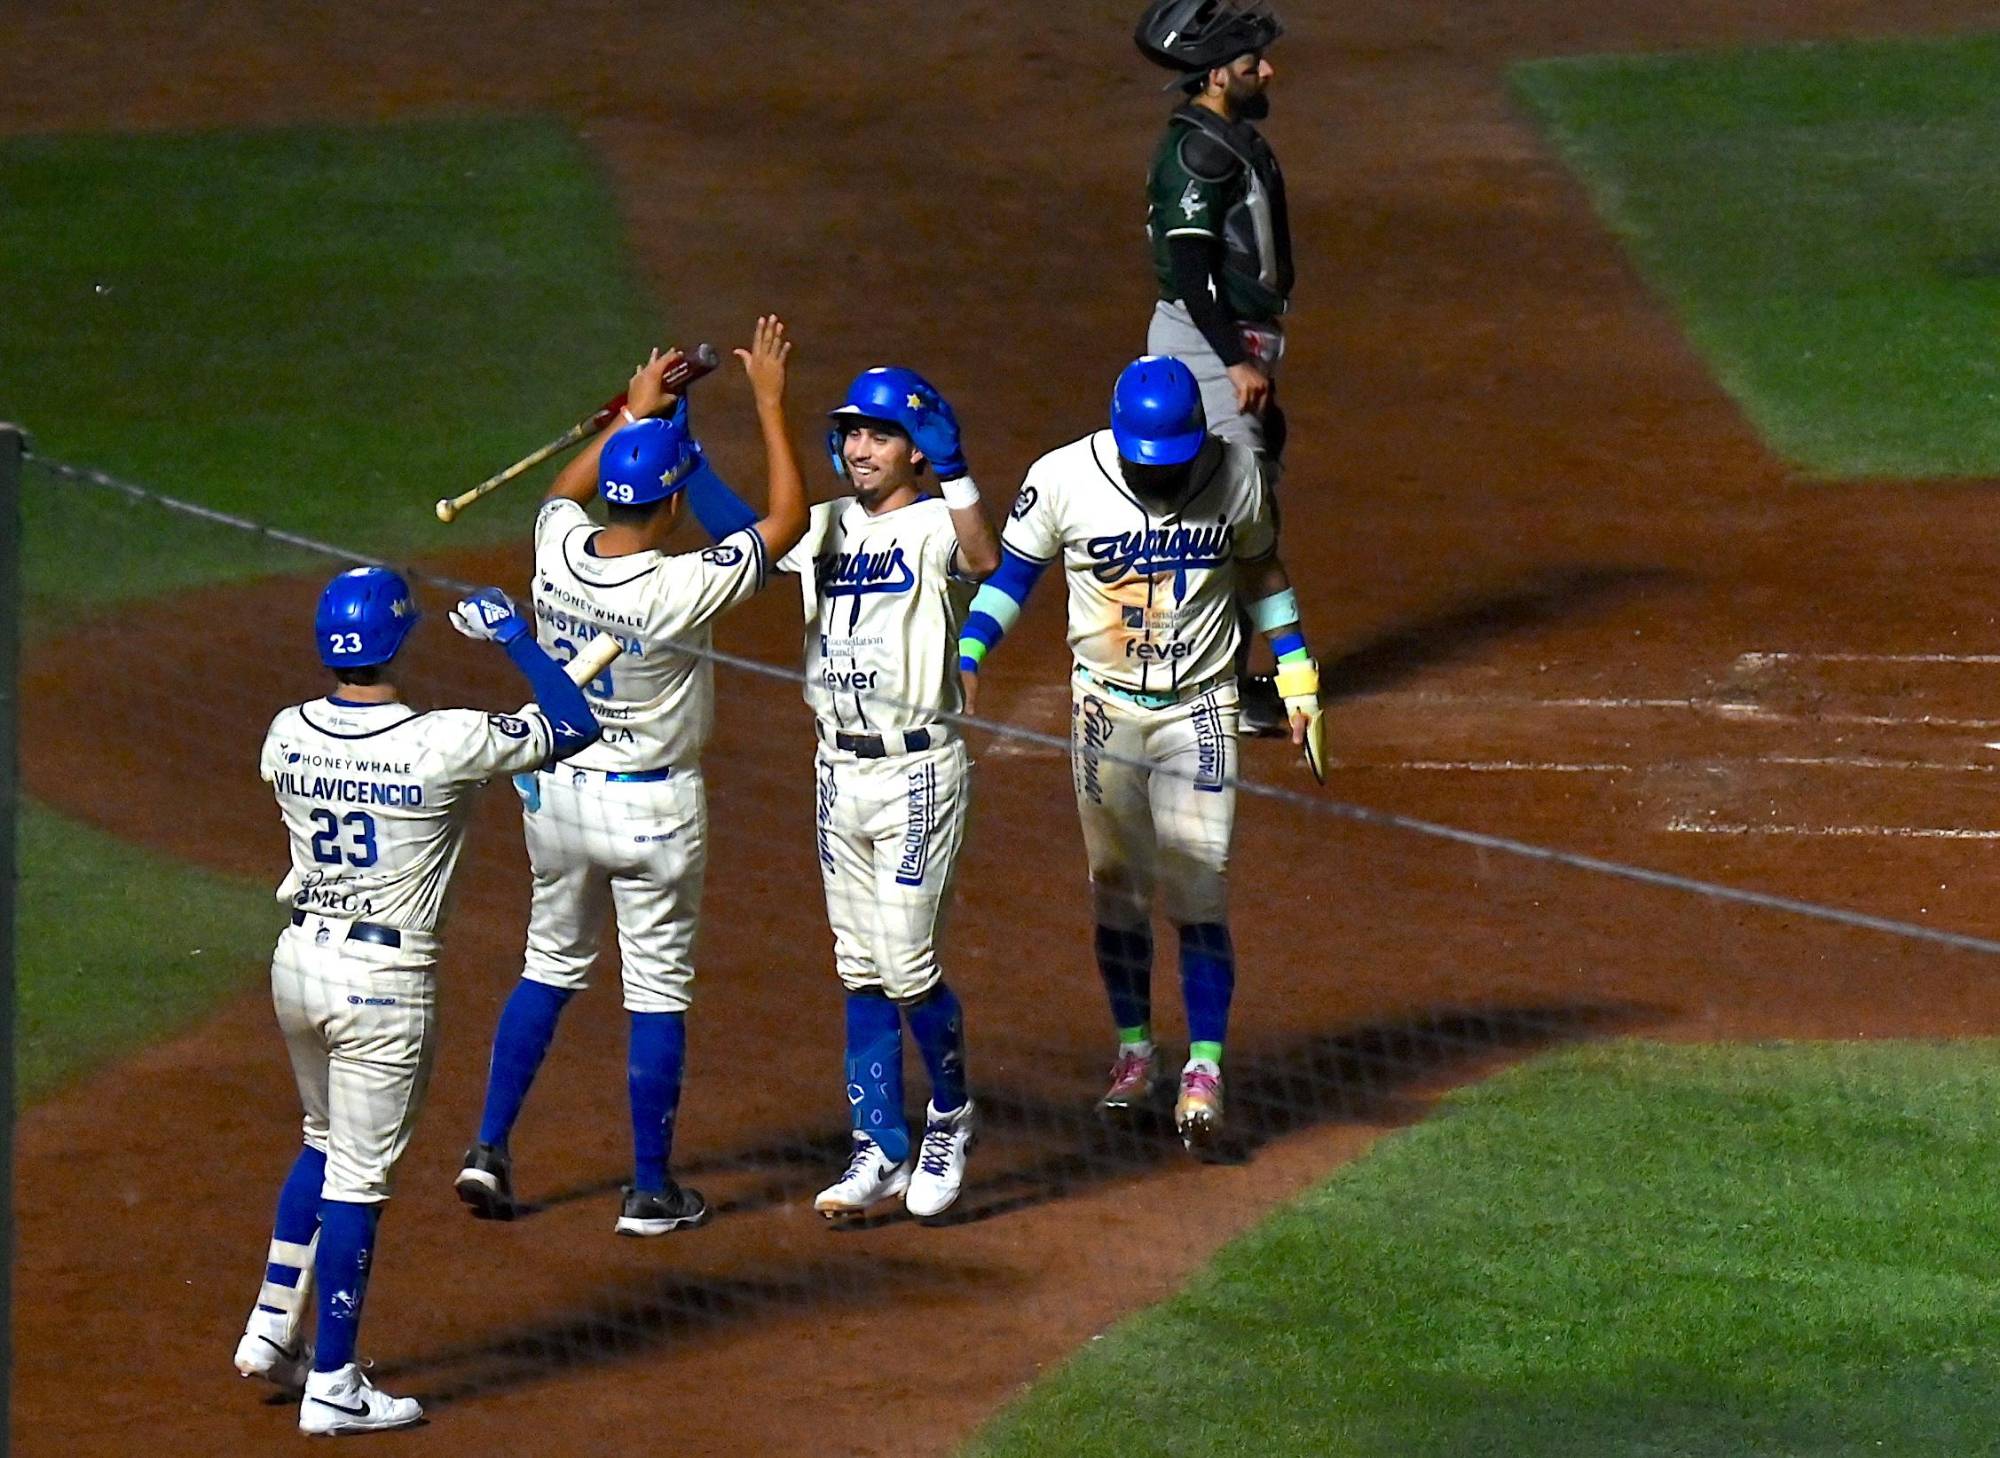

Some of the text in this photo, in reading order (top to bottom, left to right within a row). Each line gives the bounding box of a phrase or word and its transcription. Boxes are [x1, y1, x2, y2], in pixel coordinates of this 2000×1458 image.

[606, 480, 634, 503] 29
[330, 632, 362, 653] 23
[1126, 638, 1196, 659] fever
[274, 770, 423, 806] VILLAVICENCIO
[309, 808, 378, 868] 23
